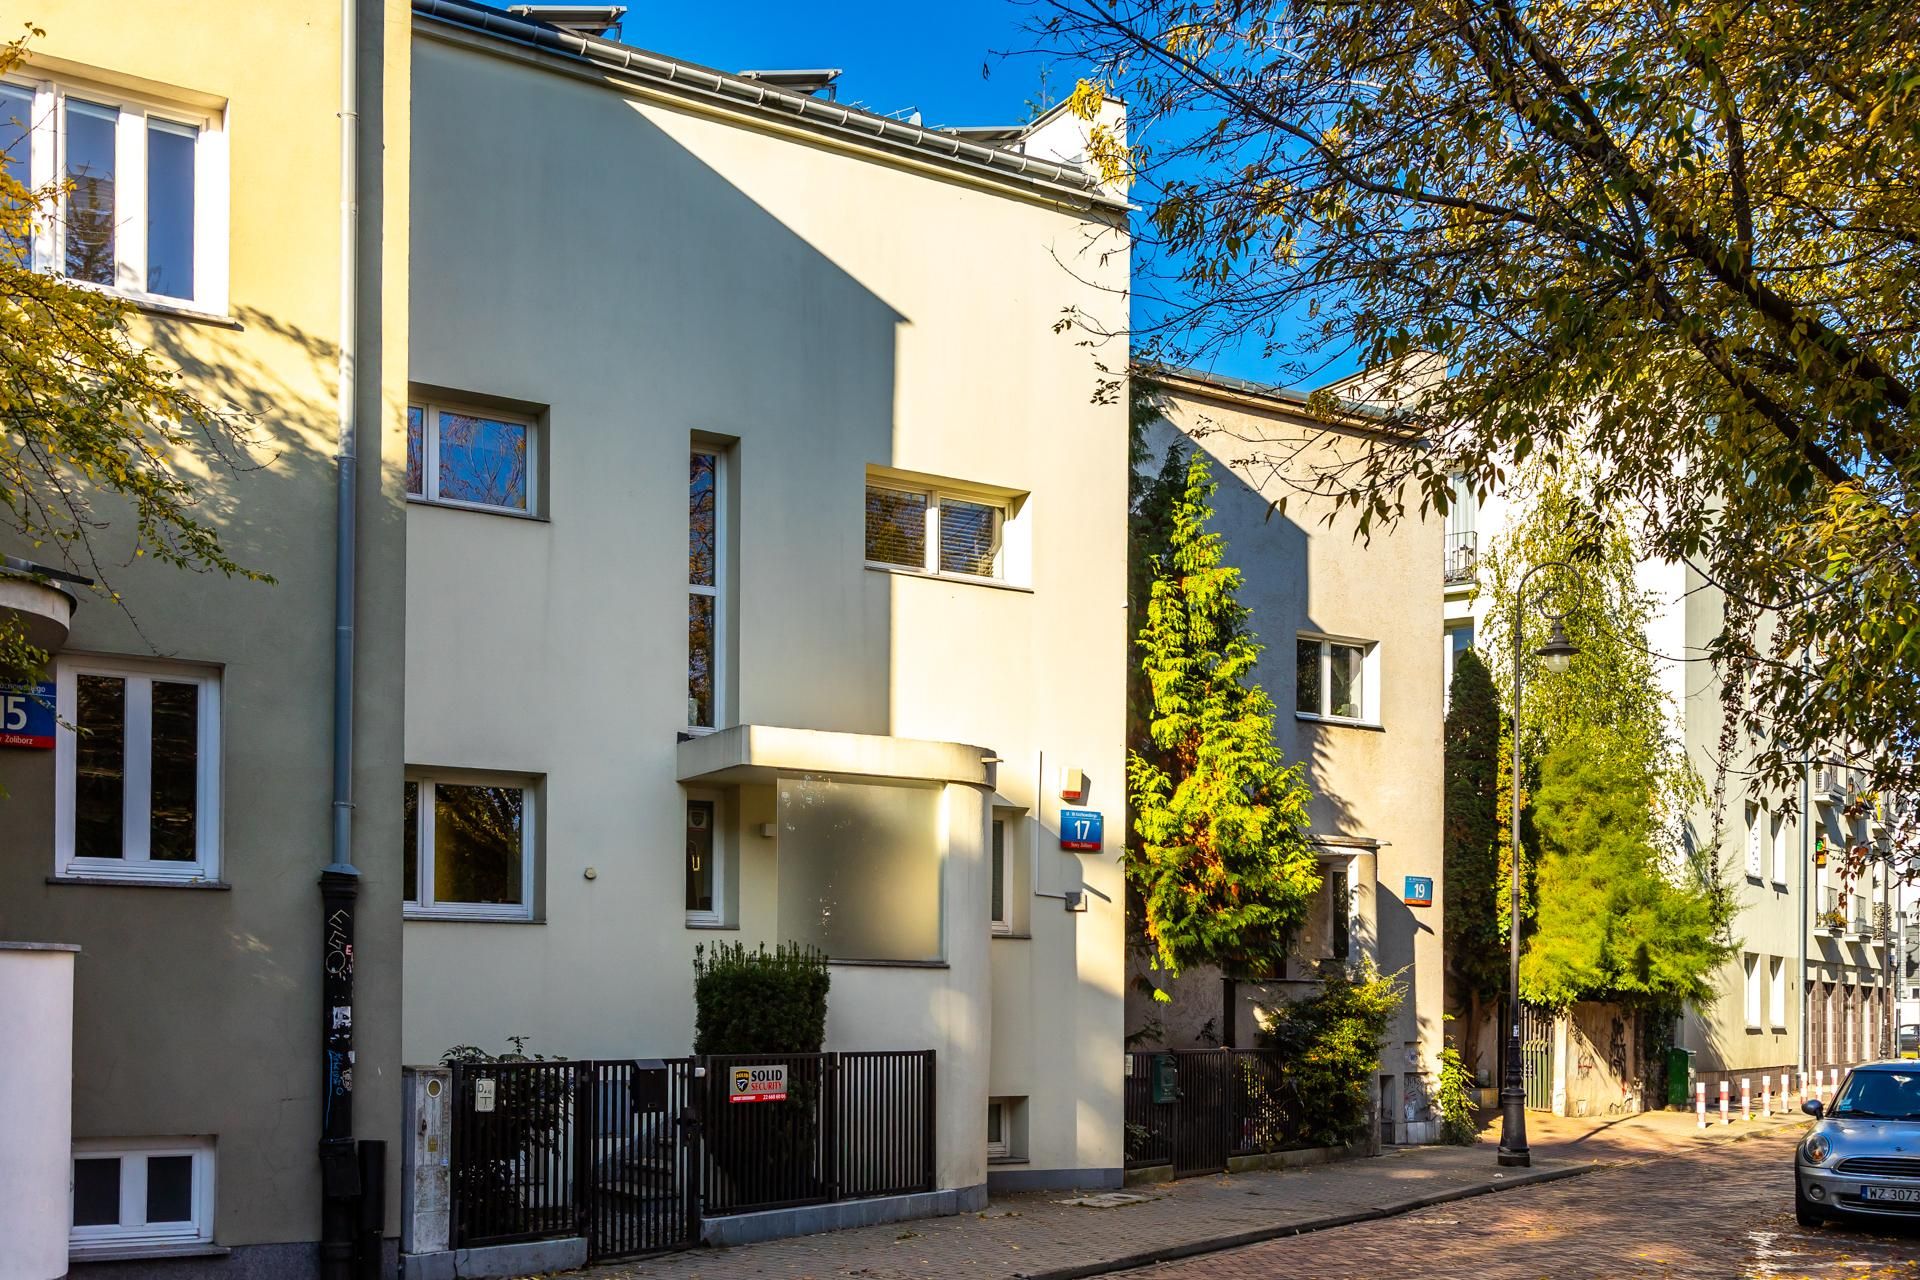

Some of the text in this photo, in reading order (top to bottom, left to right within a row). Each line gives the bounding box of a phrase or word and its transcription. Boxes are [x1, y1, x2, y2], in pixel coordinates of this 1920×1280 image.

[0, 695, 27, 731] 15
[1074, 820, 1091, 840] 17
[1414, 883, 1425, 898] 19
[751, 1070, 783, 1082] SOLID
[751, 1081, 783, 1091] SECURITY
[1870, 1188, 1920, 1201] WZ 3073
